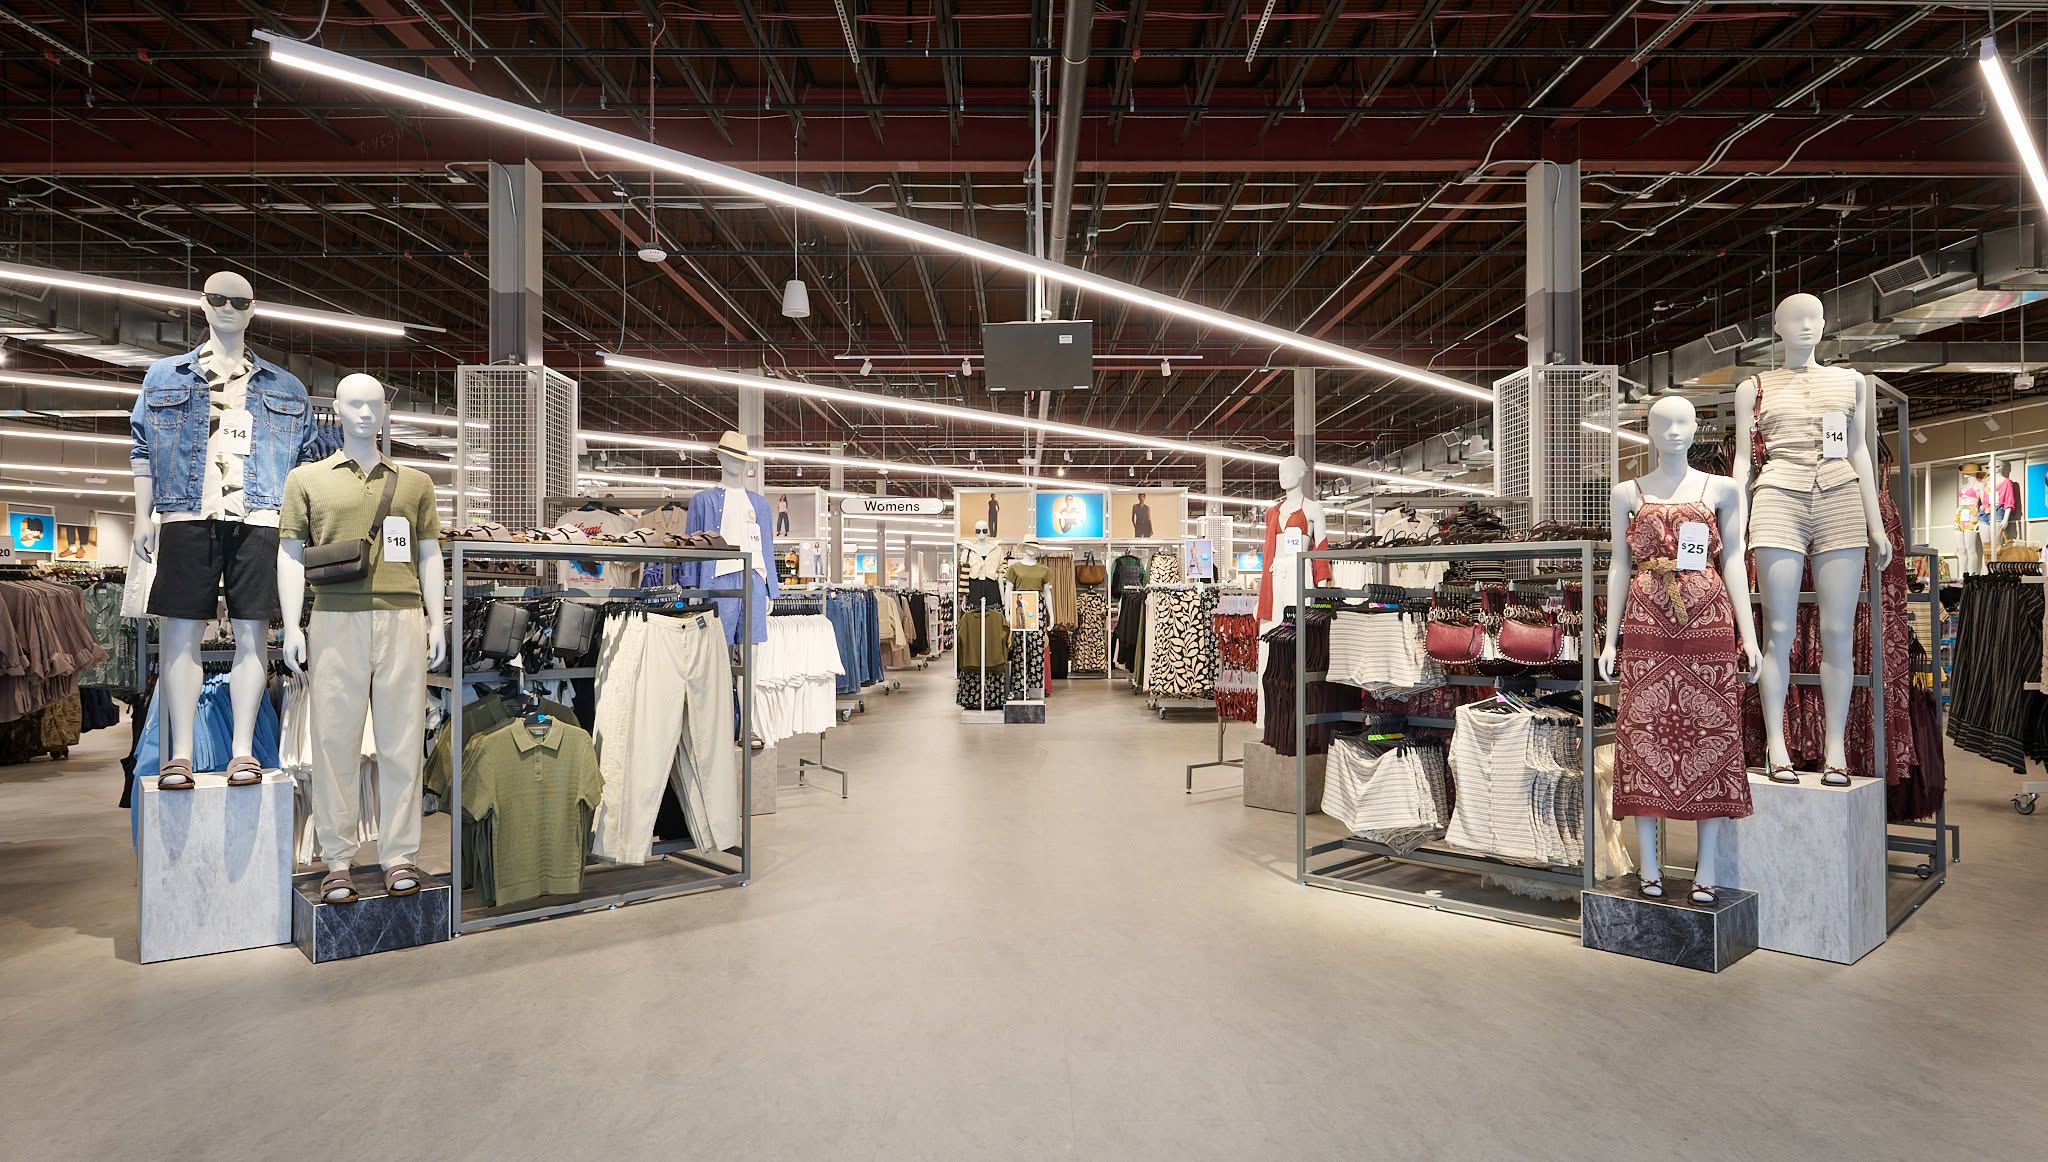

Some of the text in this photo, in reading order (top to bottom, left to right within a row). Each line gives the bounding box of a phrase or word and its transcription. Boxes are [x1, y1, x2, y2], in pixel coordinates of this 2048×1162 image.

[223, 428, 247, 439] $14
[1825, 431, 1844, 442] $14
[864, 500, 920, 512] Womens
[387, 536, 407, 547] $18
[1681, 542, 1704, 554] $25
